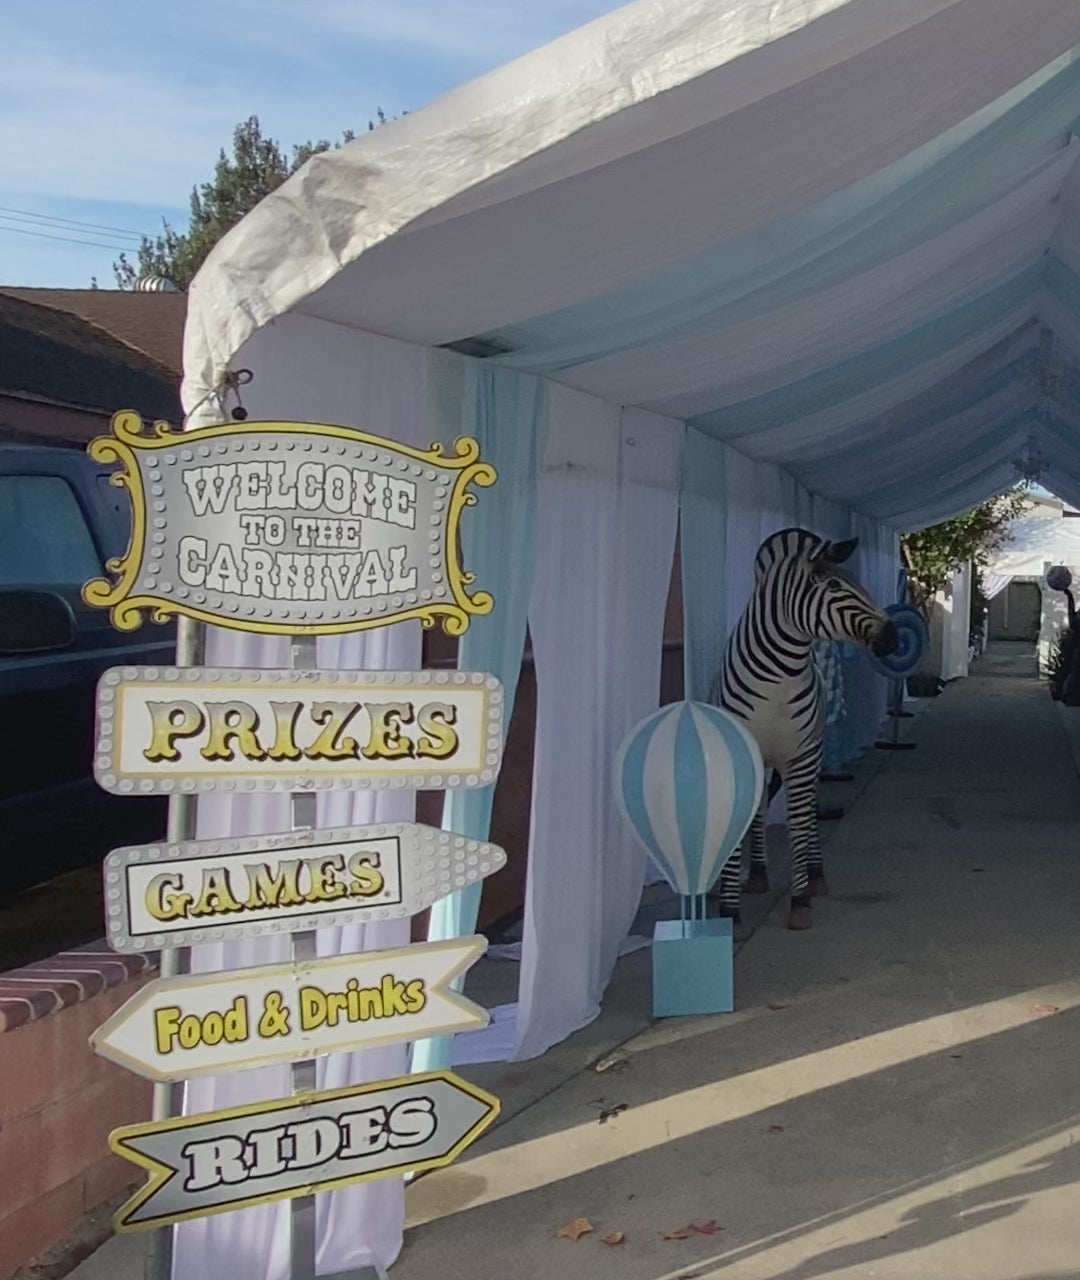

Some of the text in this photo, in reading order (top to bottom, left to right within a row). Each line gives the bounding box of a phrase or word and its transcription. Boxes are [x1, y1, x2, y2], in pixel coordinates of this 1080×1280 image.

[182, 460, 417, 530] WELCOME
[239, 514, 361, 549] TO THE
[177, 536, 417, 601] CARNIVAL
[143, 700, 459, 762] PRIZES
[145, 850, 386, 922] GAMES
[154, 974, 426, 1054] Food & Drinks
[181, 1096, 438, 1193] RIDES
